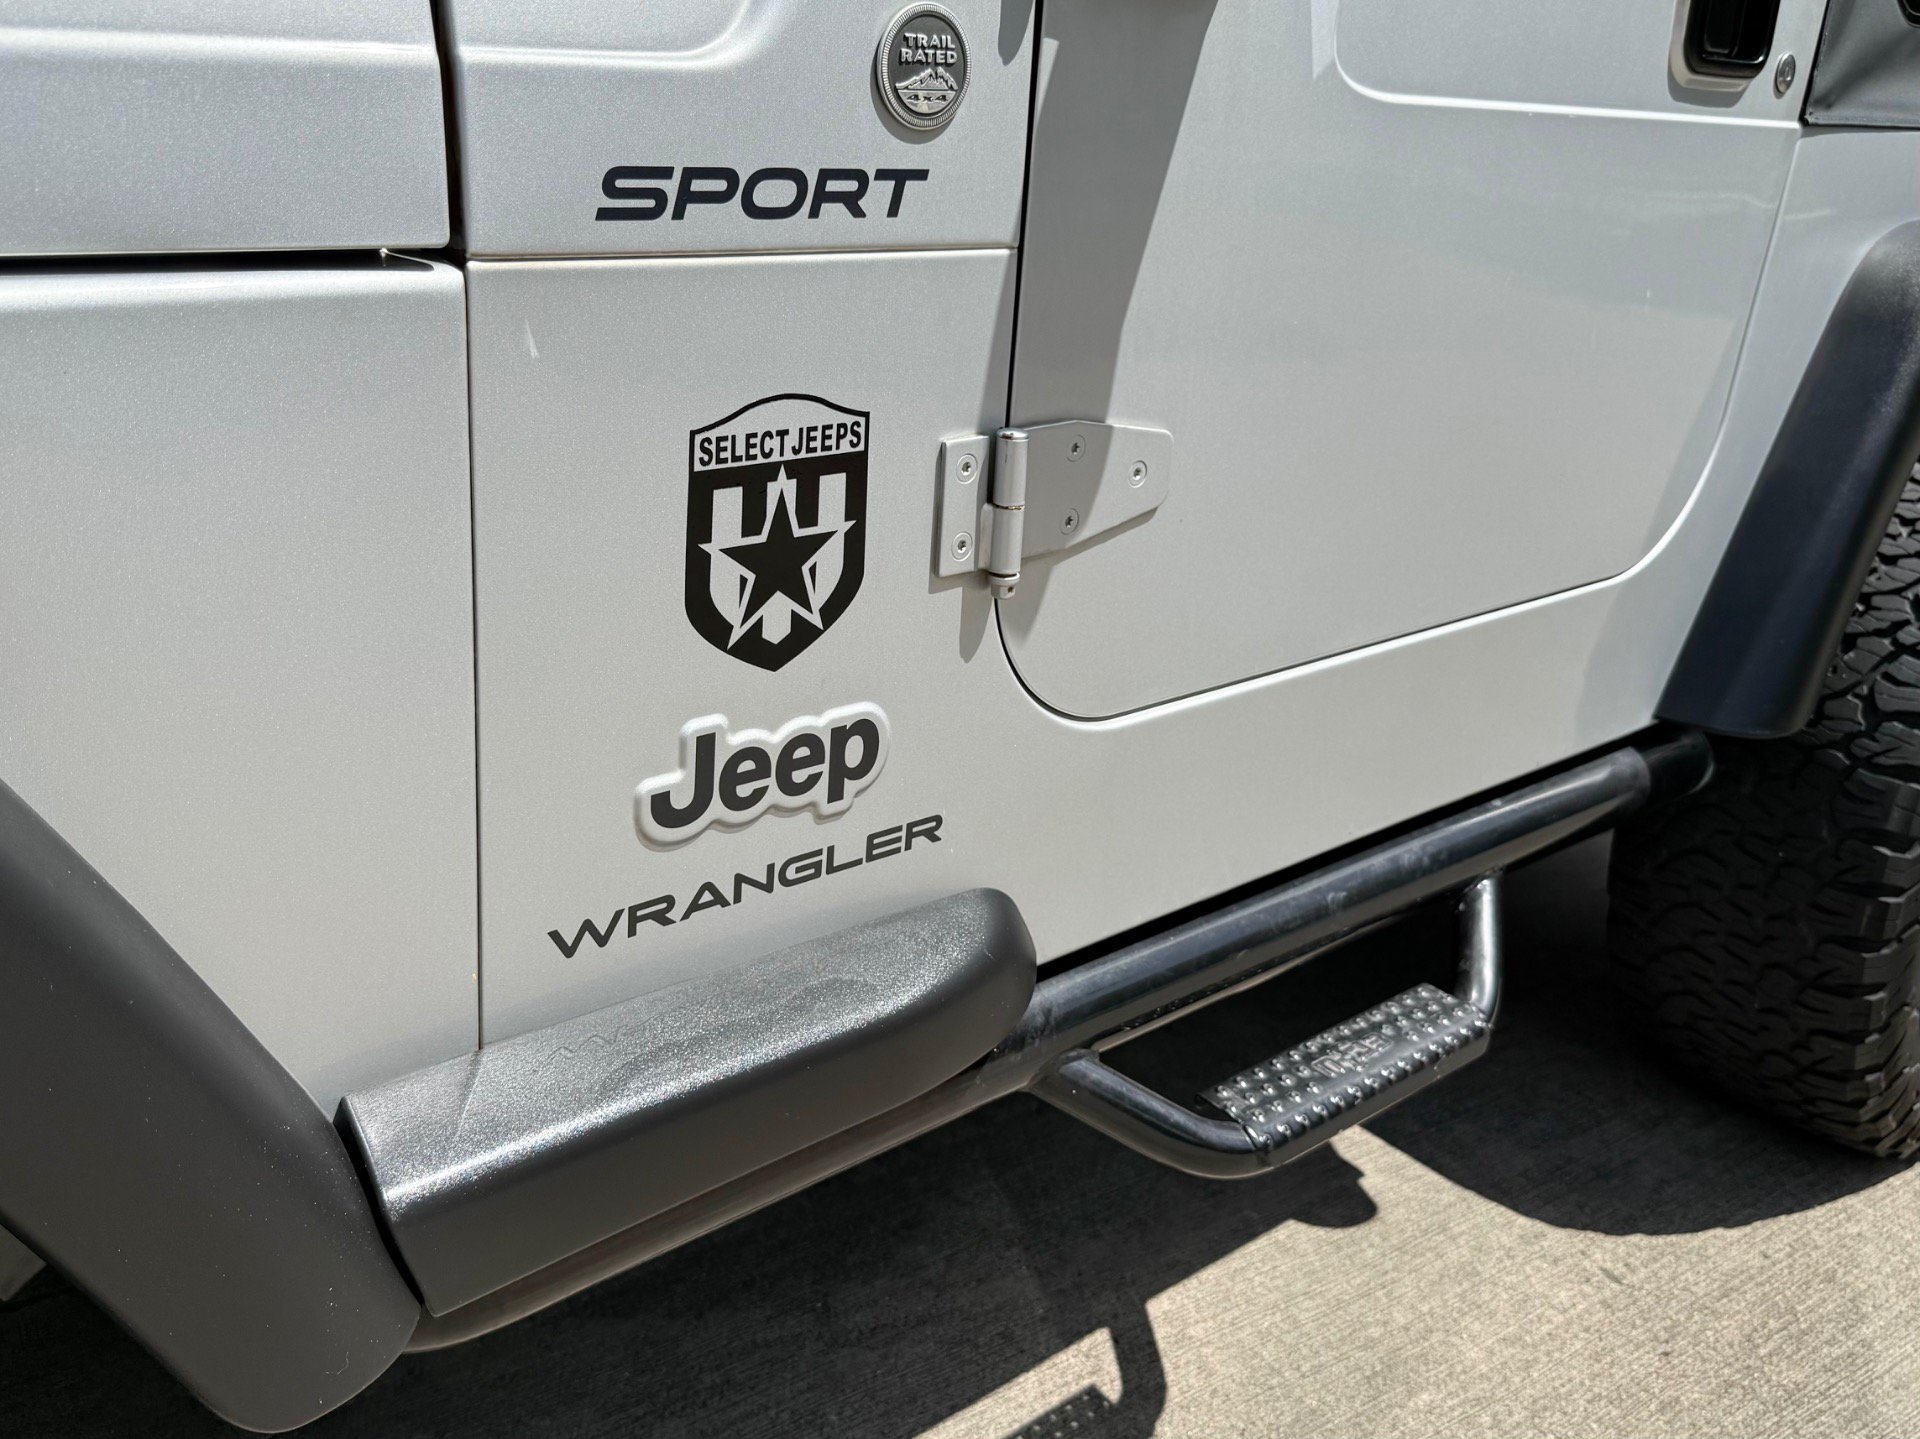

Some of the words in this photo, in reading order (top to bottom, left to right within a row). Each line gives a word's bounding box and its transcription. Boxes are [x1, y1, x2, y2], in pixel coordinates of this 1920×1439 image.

[900, 48, 958, 65] RATED
[904, 33, 956, 49] TRAIL
[595, 166, 930, 221] SPORT
[698, 428, 790, 467] SELECT
[791, 420, 862, 456] JEEPS
[650, 718, 880, 829] Jeep
[548, 814, 943, 959] WRANGLER
